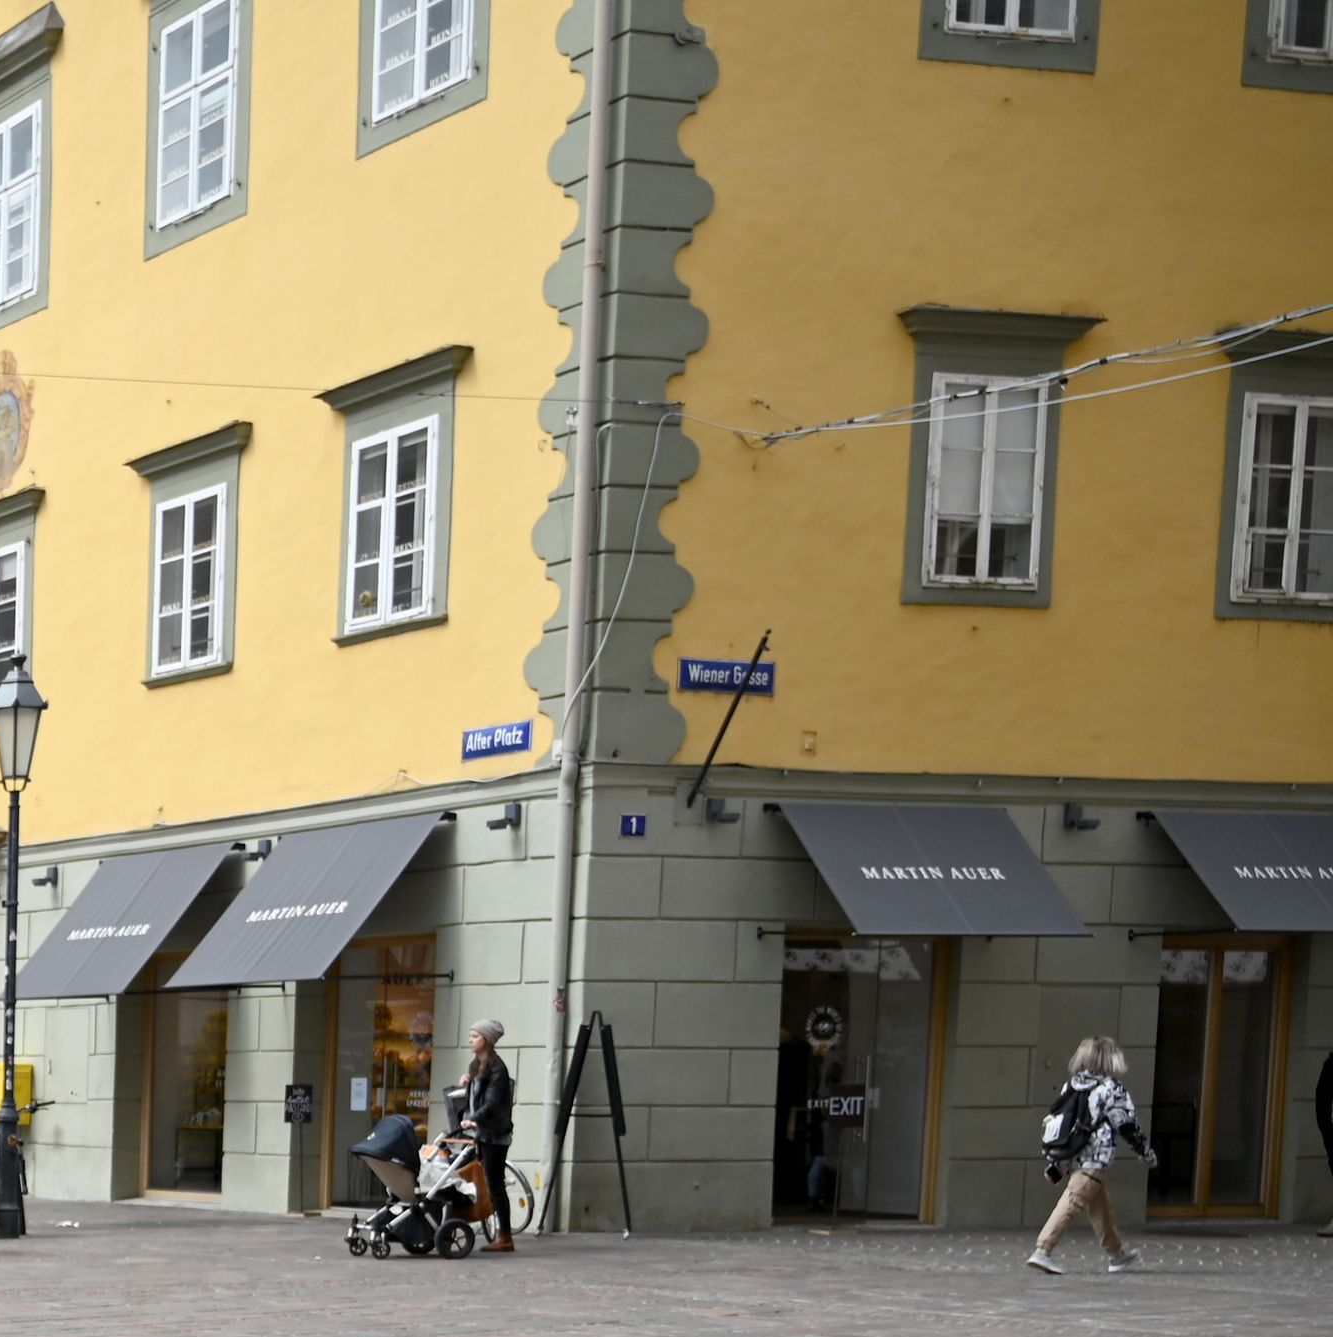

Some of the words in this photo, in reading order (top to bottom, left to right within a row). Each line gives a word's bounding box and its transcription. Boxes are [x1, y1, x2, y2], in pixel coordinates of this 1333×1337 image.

[688, 663, 730, 684] Wiener
[465, 732, 493, 752] Alter
[494, 725, 524, 748] Platz
[629, 816, 637, 834] 1
[860, 866, 944, 880] MARTIN
[950, 866, 1006, 880] AUER
[1234, 865, 1313, 879] MARTIN
[246, 905, 307, 923] MARTIN
[304, 901, 348, 916] AUER
[66, 926, 116, 941] MARTIN
[114, 923, 150, 937] AUER
[807, 1099, 829, 1109] EXIT
[829, 1097, 863, 1116] EXIT
